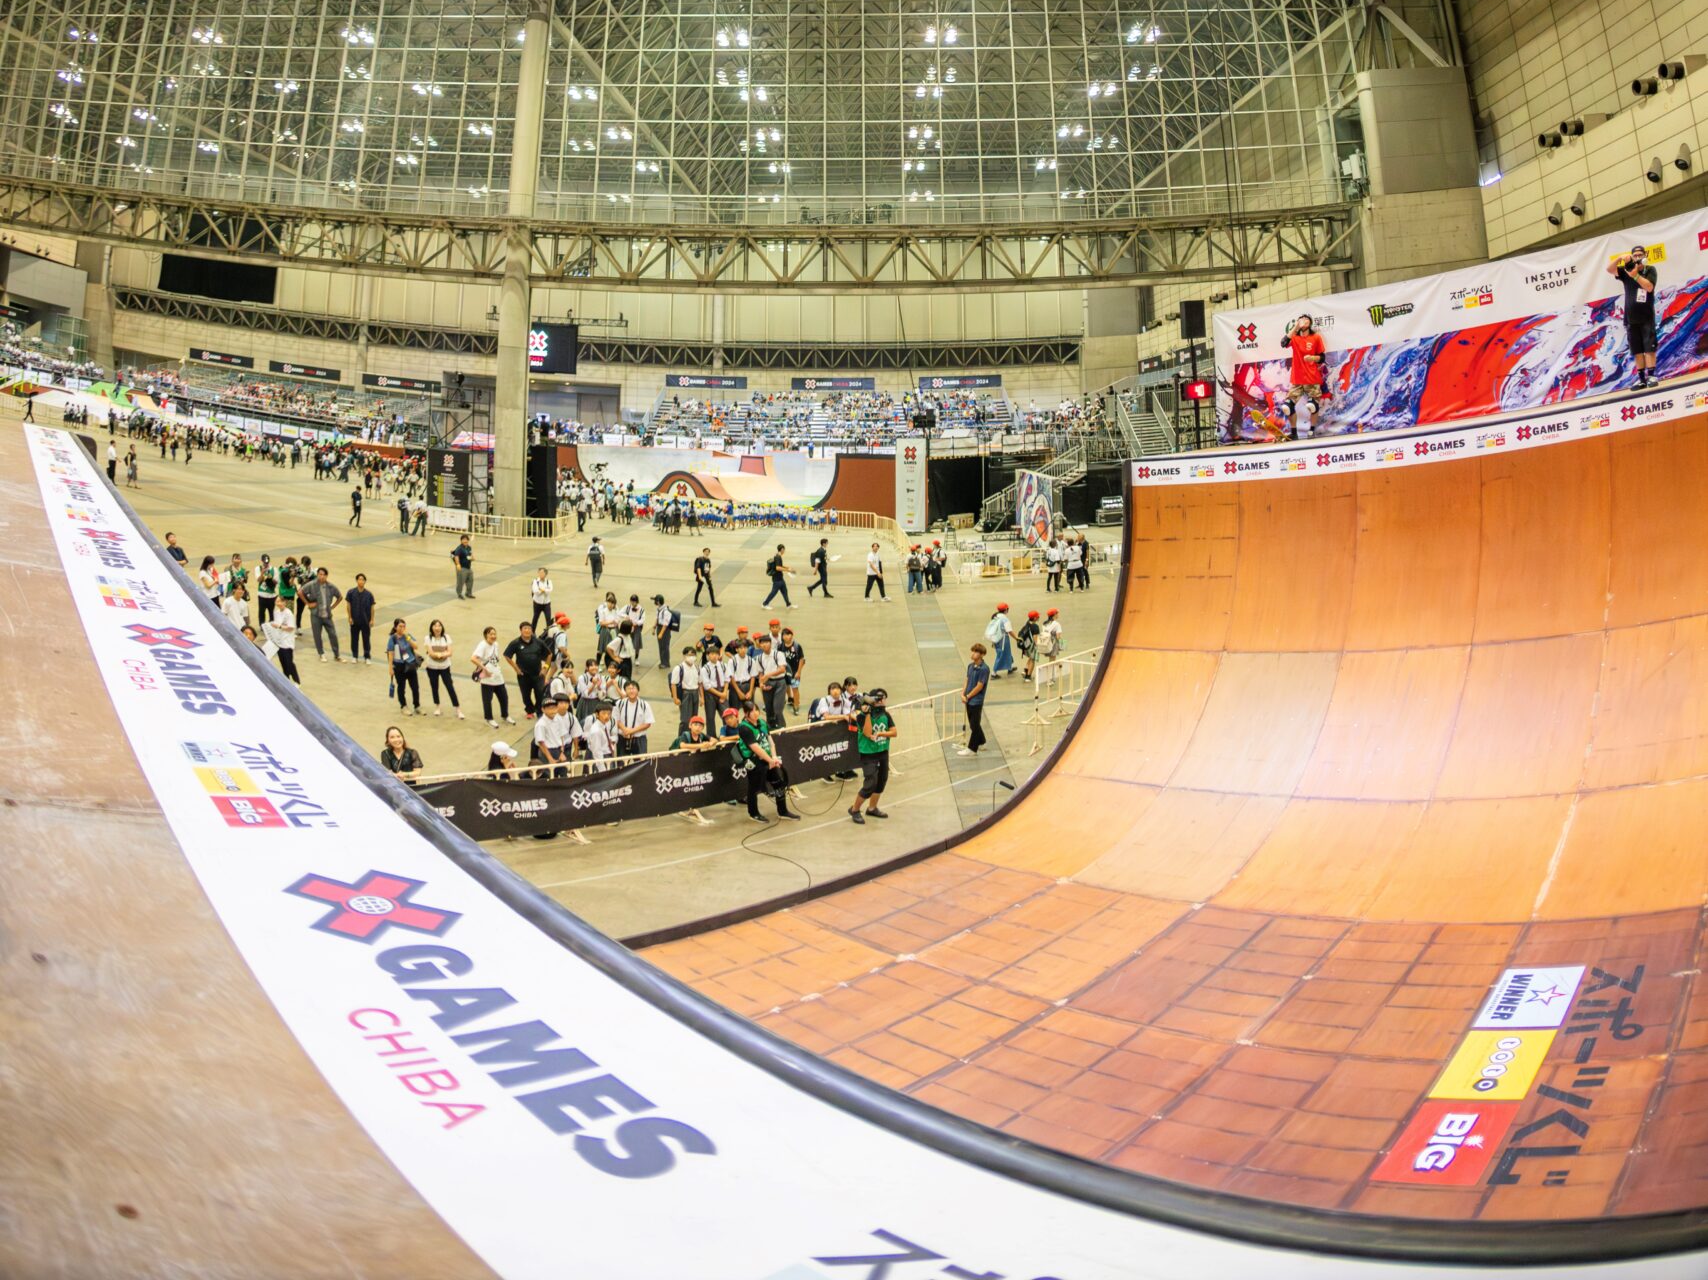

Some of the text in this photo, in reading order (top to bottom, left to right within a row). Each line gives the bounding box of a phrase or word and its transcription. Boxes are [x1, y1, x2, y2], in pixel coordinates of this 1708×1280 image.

[1525, 265, 1577, 284] INSTYLE
[1535, 278, 1569, 291] GROUP
[1313, 315, 1335, 328] 葉市
[1237, 342, 1258, 350] GAMES
[1637, 399, 1674, 415] GAMES
[1532, 421, 1569, 436] GAMES
[1429, 439, 1466, 452] GAMES
[1331, 452, 1366, 463] GAMES
[1150, 468, 1181, 476] GAMES
[1237, 461, 1270, 471] GAMES
[92, 539, 136, 570] GAMES
[122, 658, 159, 691] CHIBA
[149, 648, 237, 717] GAMES
[814, 741, 849, 757] GAMES
[823, 752, 841, 762] CHIBA
[230, 742, 340, 828] スポーツくじ
[673, 772, 714, 788] GAMES
[591, 784, 633, 804] GAMES
[683, 785, 704, 794] CHIBA
[501, 798, 548, 813] GAMES
[602, 798, 622, 807] CHIBA
[229, 798, 265, 825] BIG
[434, 805, 456, 817] ES
[1490, 974, 1534, 1020] WINNER
[348, 1006, 489, 1131] CHIBA
[375, 943, 720, 1180] GAMES
[1486, 964, 1646, 1186] スポーツくじ
[1412, 1113, 1481, 1173] BIG
